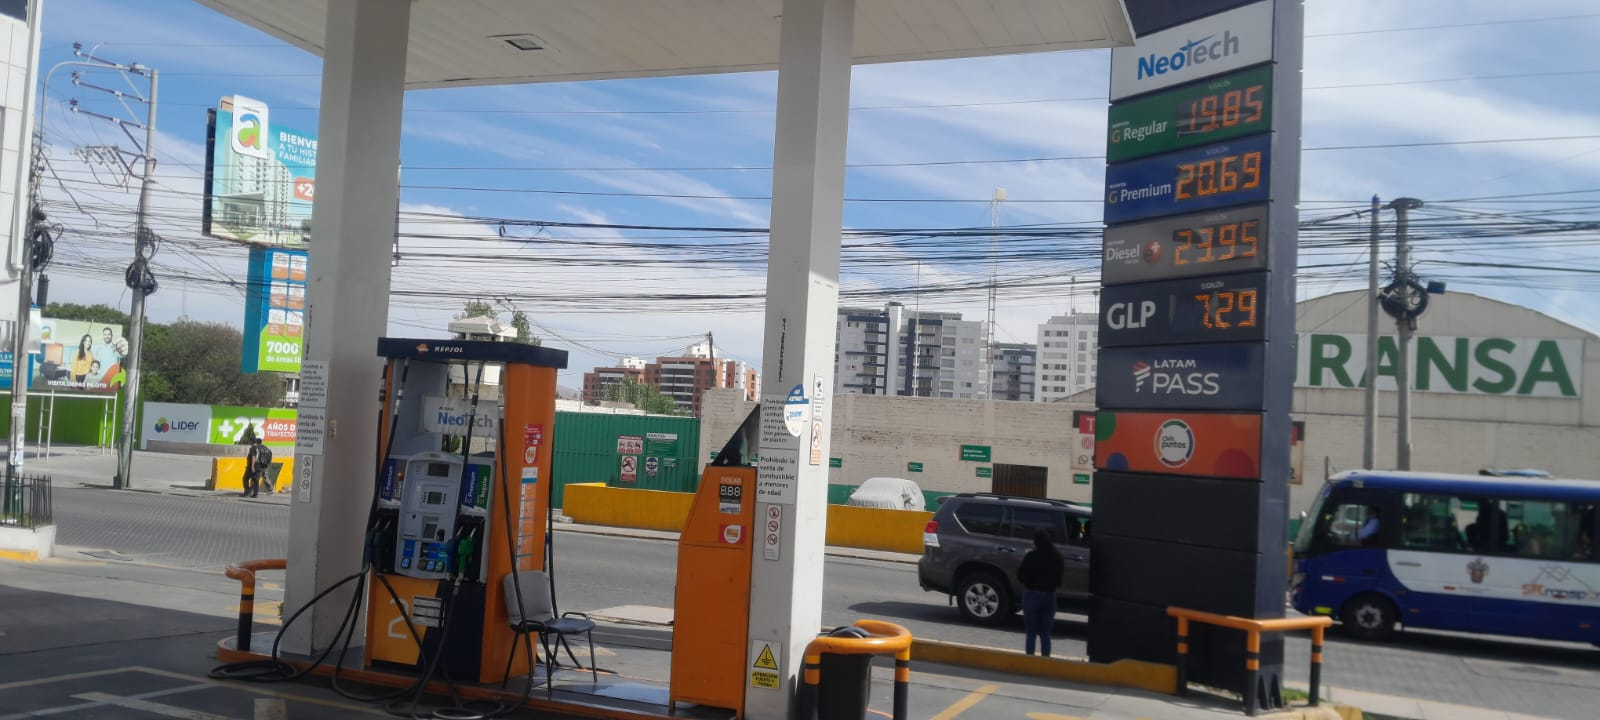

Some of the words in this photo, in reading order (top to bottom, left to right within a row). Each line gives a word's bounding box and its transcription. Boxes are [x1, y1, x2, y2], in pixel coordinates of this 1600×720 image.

[1137, 30, 1240, 80] NeoTech
[1123, 120, 1169, 142] Regular
[287, 144, 298, 153] TU
[1120, 183, 1171, 202] Premium
[1106, 243, 1140, 261] Diesel
[1106, 300, 1157, 330] GLP
[1154, 359, 1197, 369] LATAM
[1152, 373, 1220, 396] PASS
[267, 421, 288, 431] AÑOS
[1162, 441, 1186, 449] puntos
[761, 456, 788, 464] Prohibido
